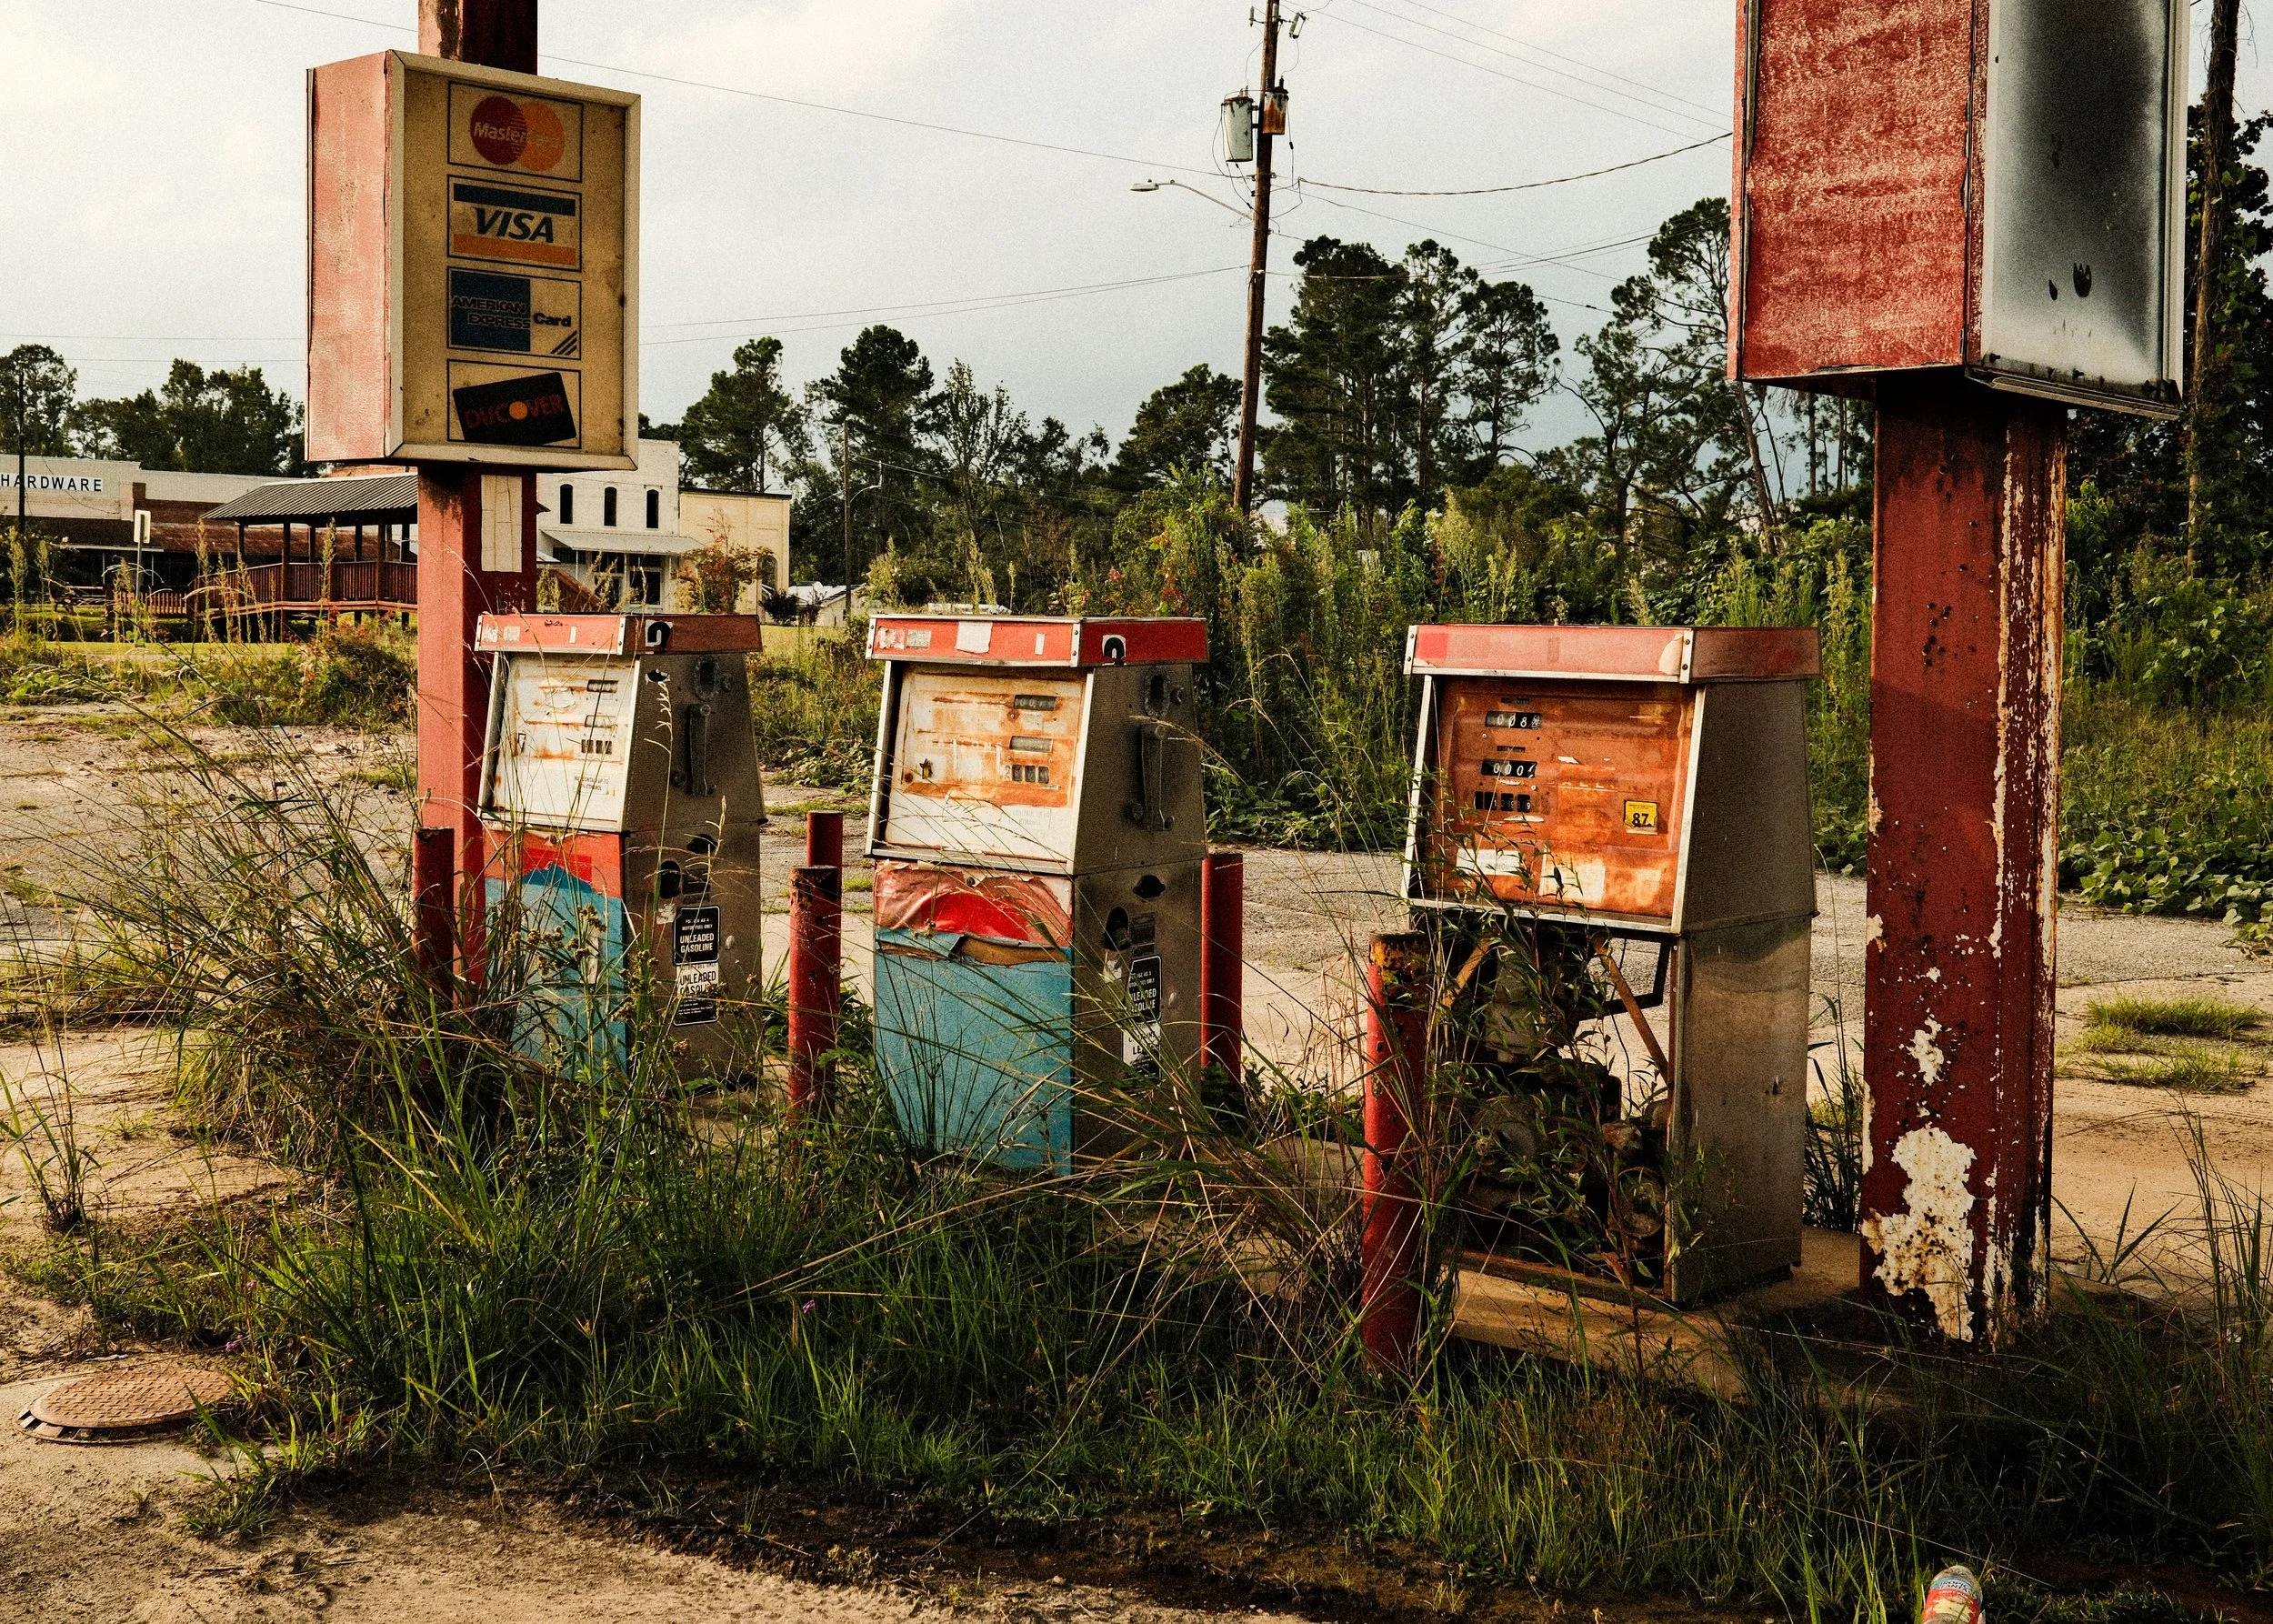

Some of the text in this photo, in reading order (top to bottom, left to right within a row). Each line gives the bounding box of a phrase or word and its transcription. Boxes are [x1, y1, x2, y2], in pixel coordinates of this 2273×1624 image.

[473, 207, 554, 244] VISA
[451, 296, 526, 315] AMERICAN
[467, 312, 572, 331] EXPRESS Card
[1, 474, 102, 492] HARDWARE
[1632, 812, 1649, 826] 87
[679, 933, 715, 944] UNLEADED
[680, 943, 714, 954] GASOLINE
[680, 970, 716, 986] UNLEADED
[680, 983, 709, 997] GASOL
[1131, 987, 1157, 1002] LEDED
